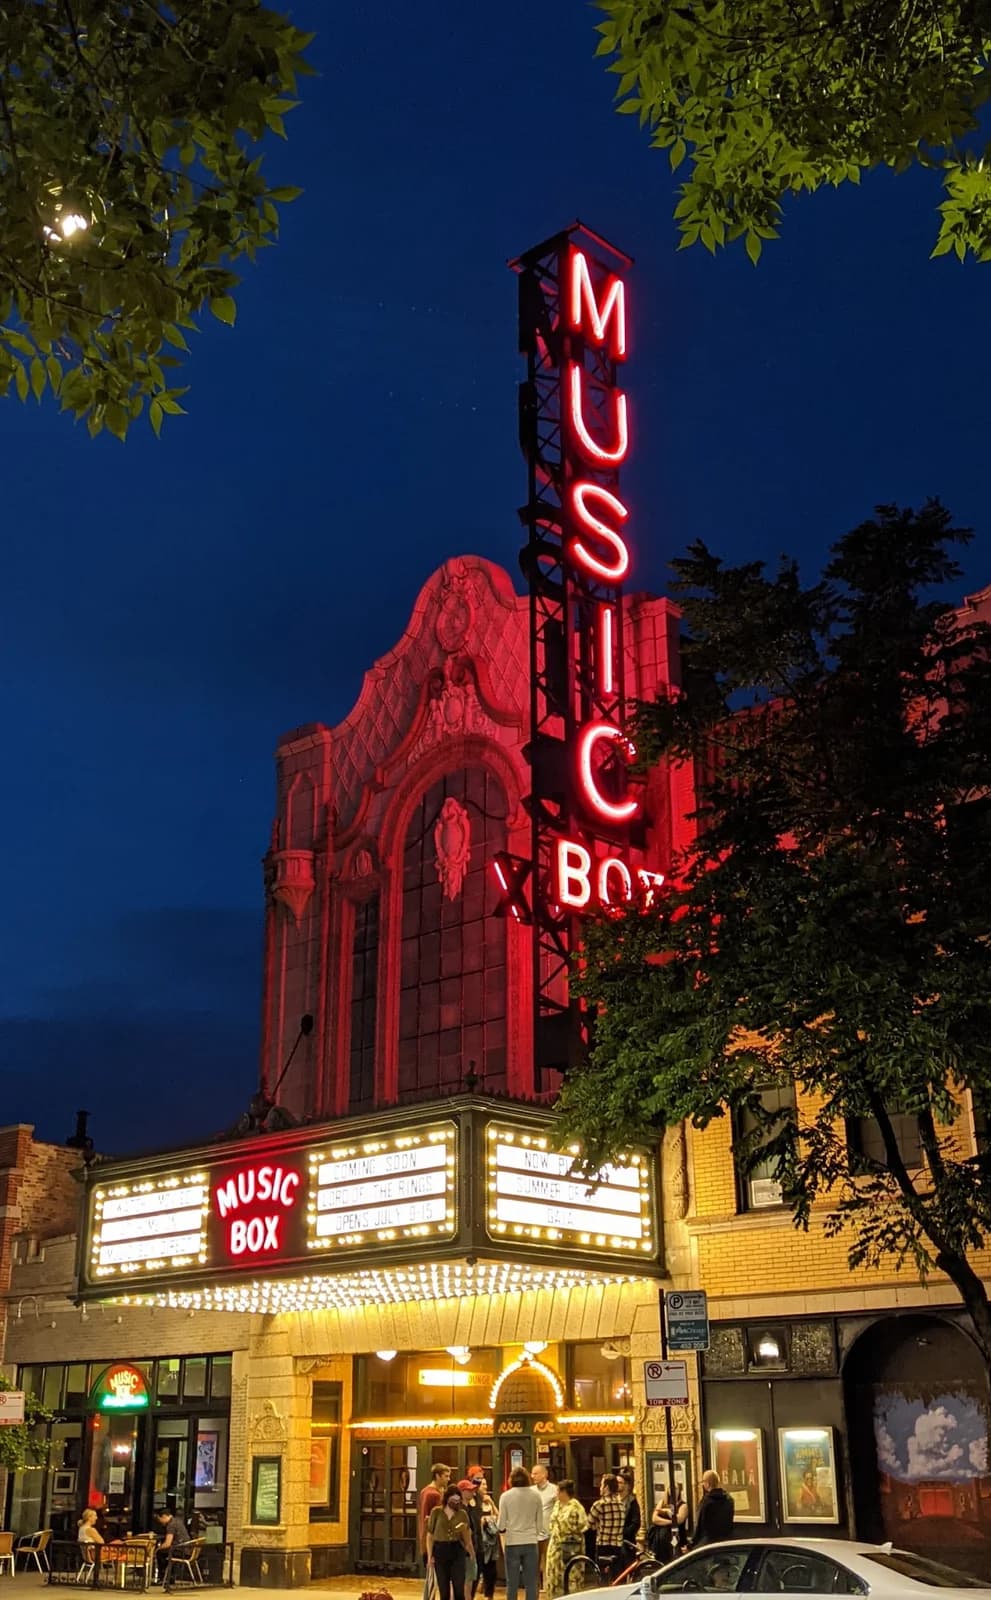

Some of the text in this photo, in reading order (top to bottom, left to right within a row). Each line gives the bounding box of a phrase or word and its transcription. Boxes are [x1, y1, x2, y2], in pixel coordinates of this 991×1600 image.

[567, 250, 638, 818] MUSIC
[334, 1152, 417, 1181] COMING SOON
[524, 1151, 549, 1169] NOW
[217, 1166, 300, 1217] MUSIC
[373, 1182, 393, 1199] THE
[397, 1176, 433, 1195] RINGS
[516, 1176, 561, 1199] SUMMER
[335, 1211, 369, 1231] OPENS
[374, 1207, 401, 1227] JULY
[230, 1215, 279, 1254] BOX
[109, 1370, 139, 1390] MUSIC
[721, 1469, 756, 1487] GAIA
